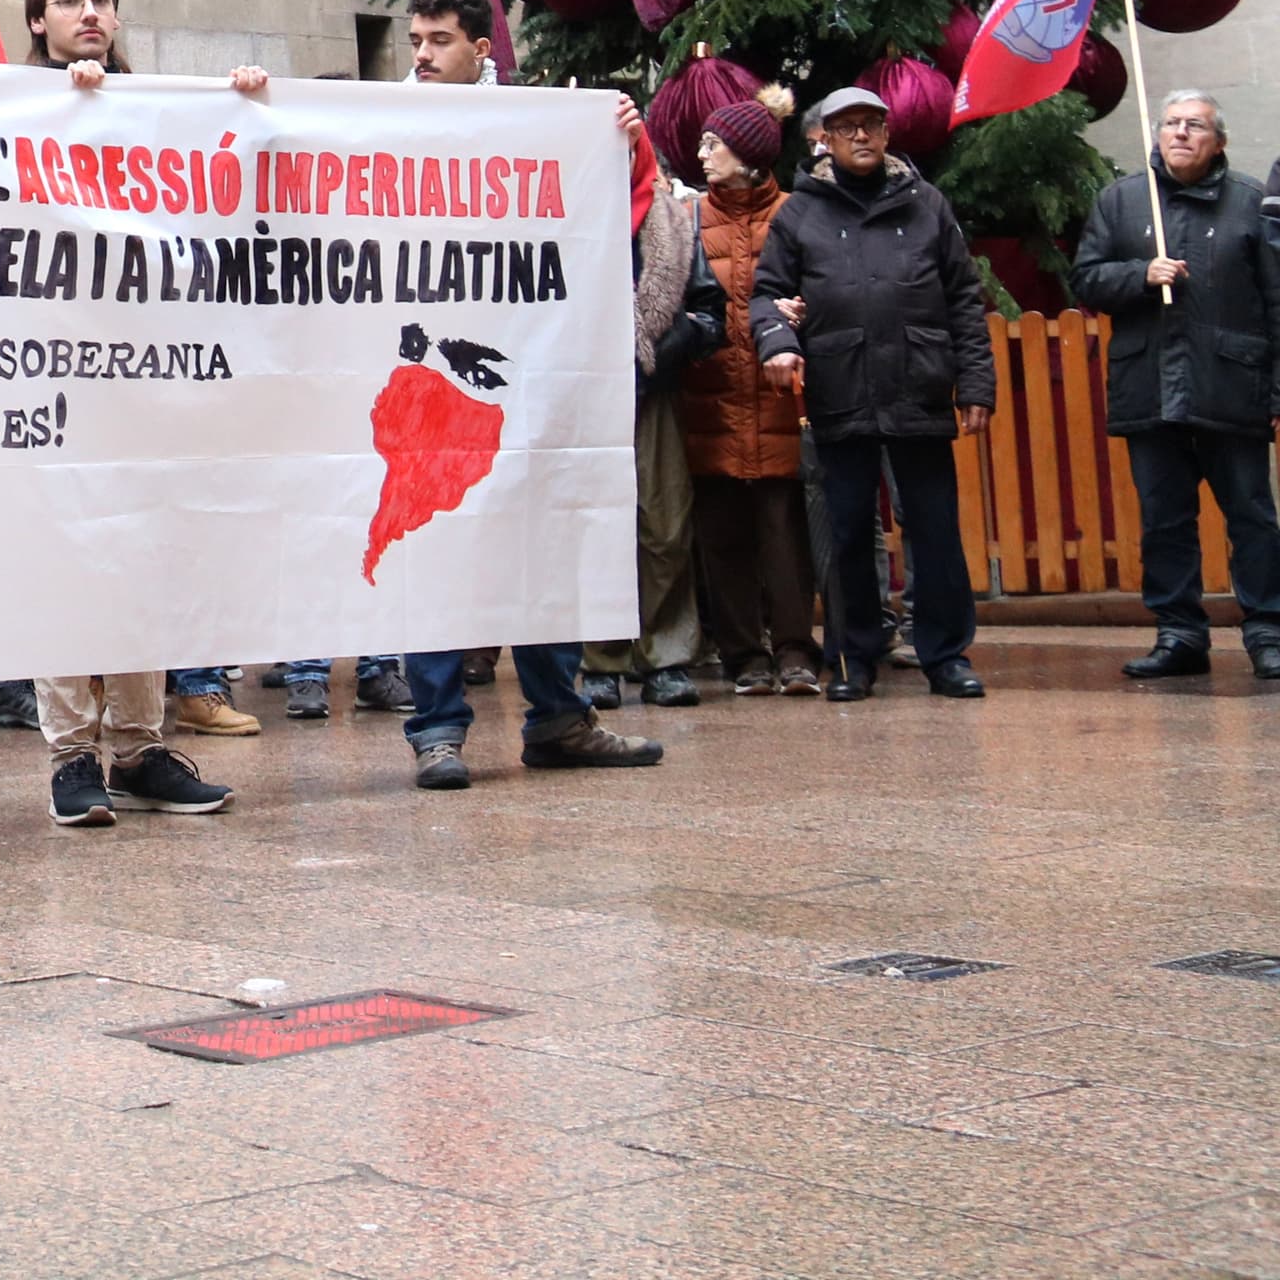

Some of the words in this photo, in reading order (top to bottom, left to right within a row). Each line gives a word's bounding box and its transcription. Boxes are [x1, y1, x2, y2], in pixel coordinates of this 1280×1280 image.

[255, 150, 565, 220] IMPERIALISTA
[91, 232, 108, 300] I
[116, 234, 148, 304] A
[159, 219, 383, 306] L'AMÈRICA
[395, 240, 567, 304] LLATINA
